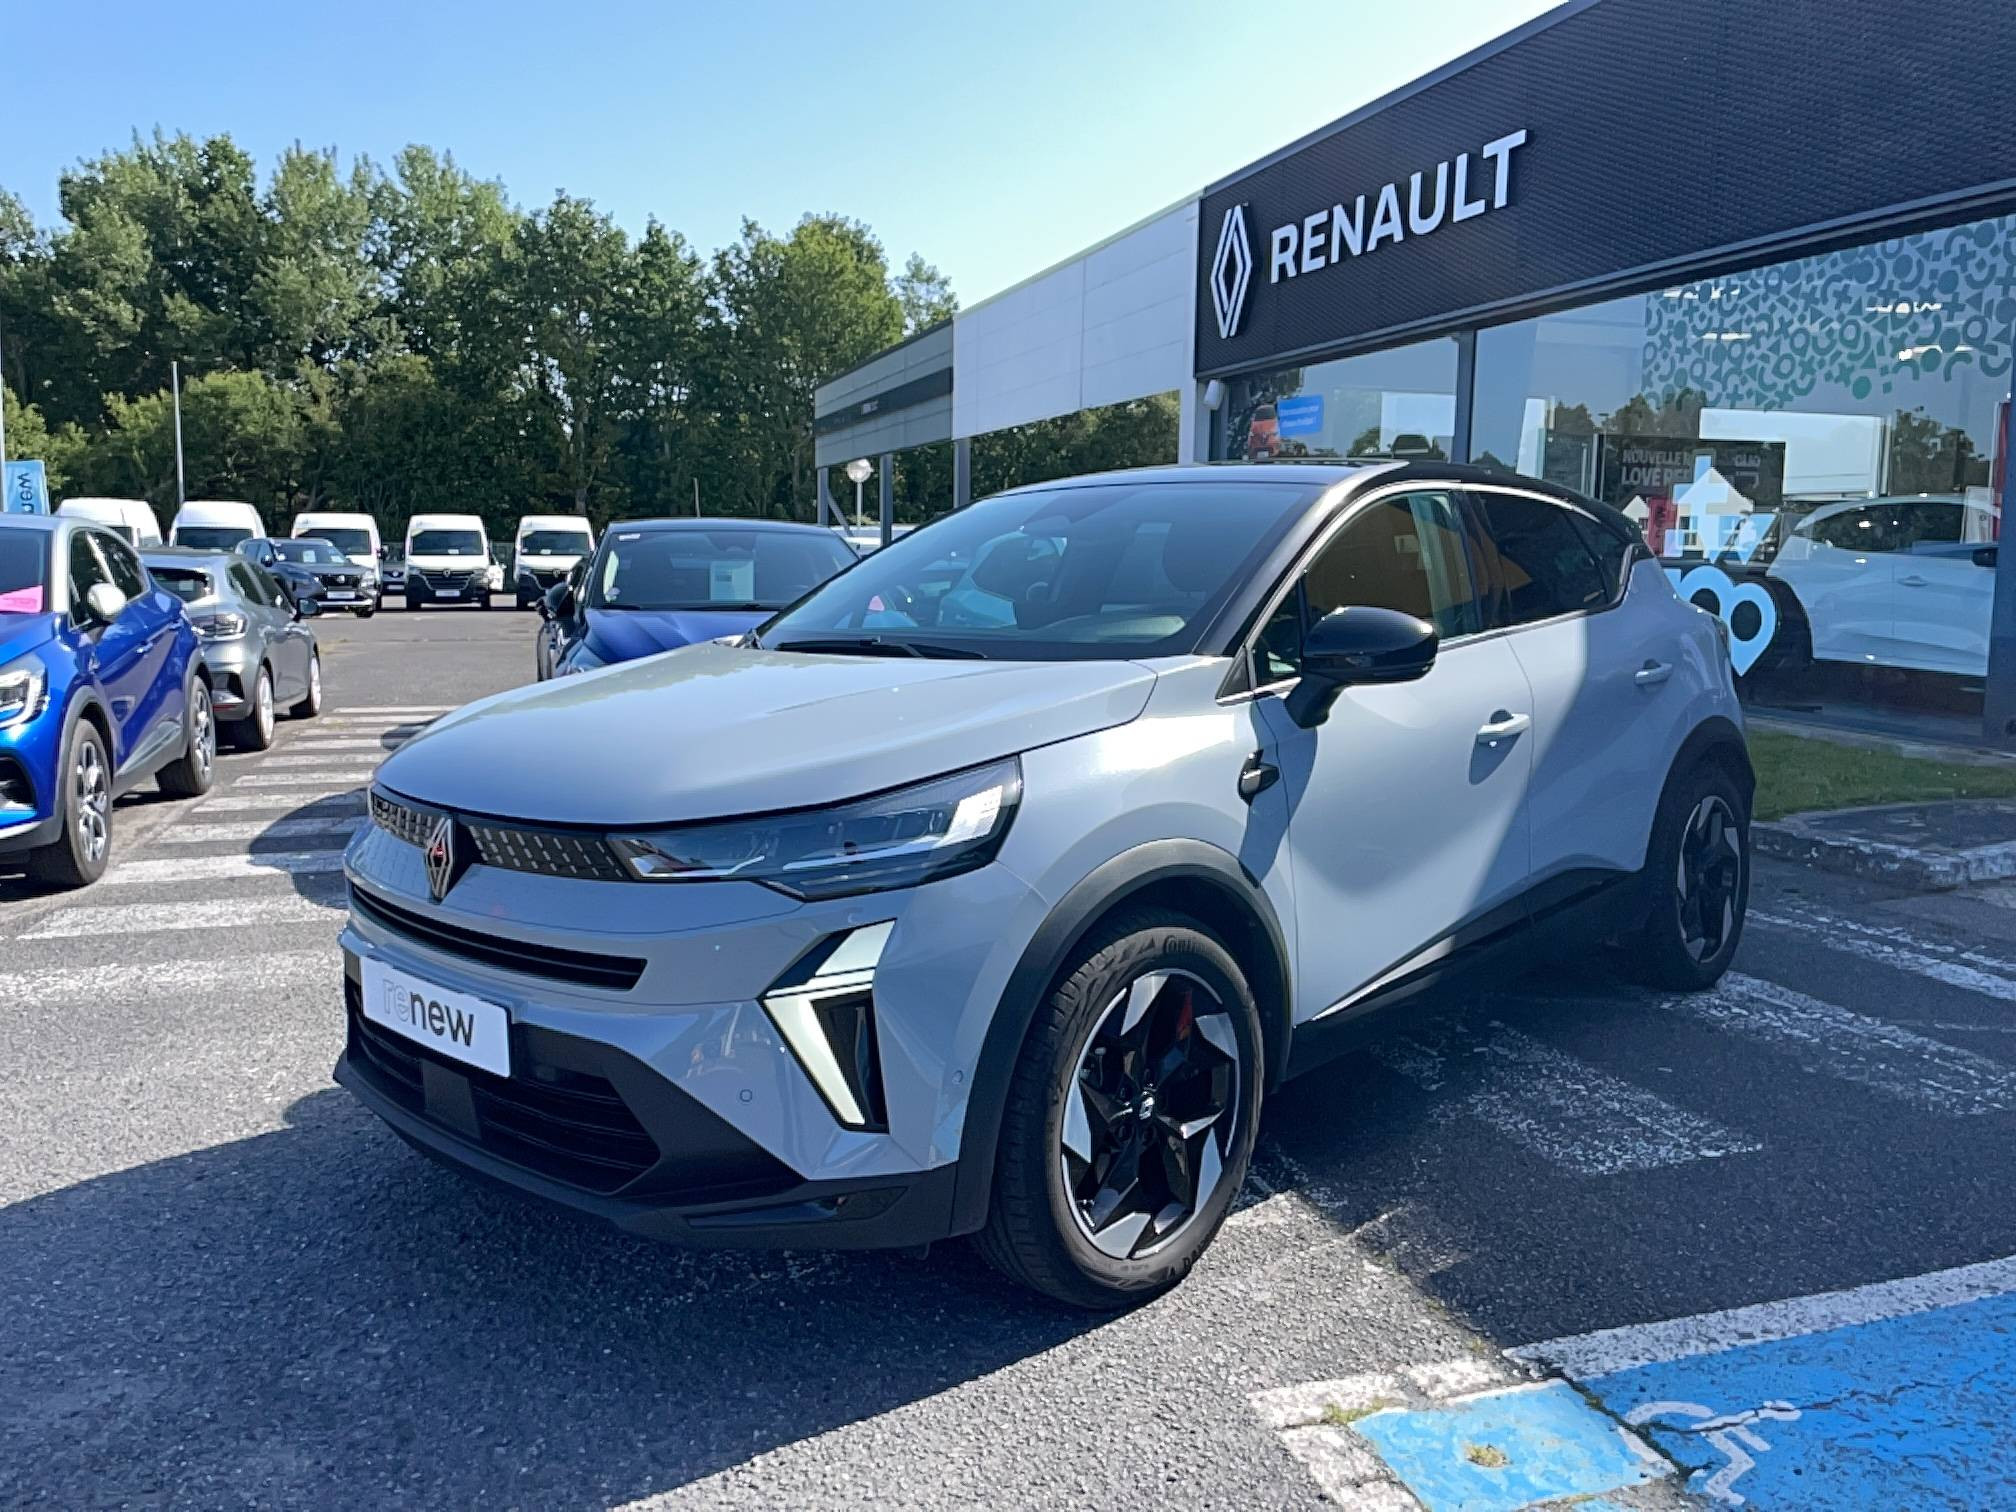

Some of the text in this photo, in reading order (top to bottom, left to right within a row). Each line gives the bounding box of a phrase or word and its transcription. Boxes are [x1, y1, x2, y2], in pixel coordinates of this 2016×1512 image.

[1270, 128, 1528, 284] RENAULT
[1621, 466, 1663, 487] LOVE
[382, 978, 475, 1048] renew
